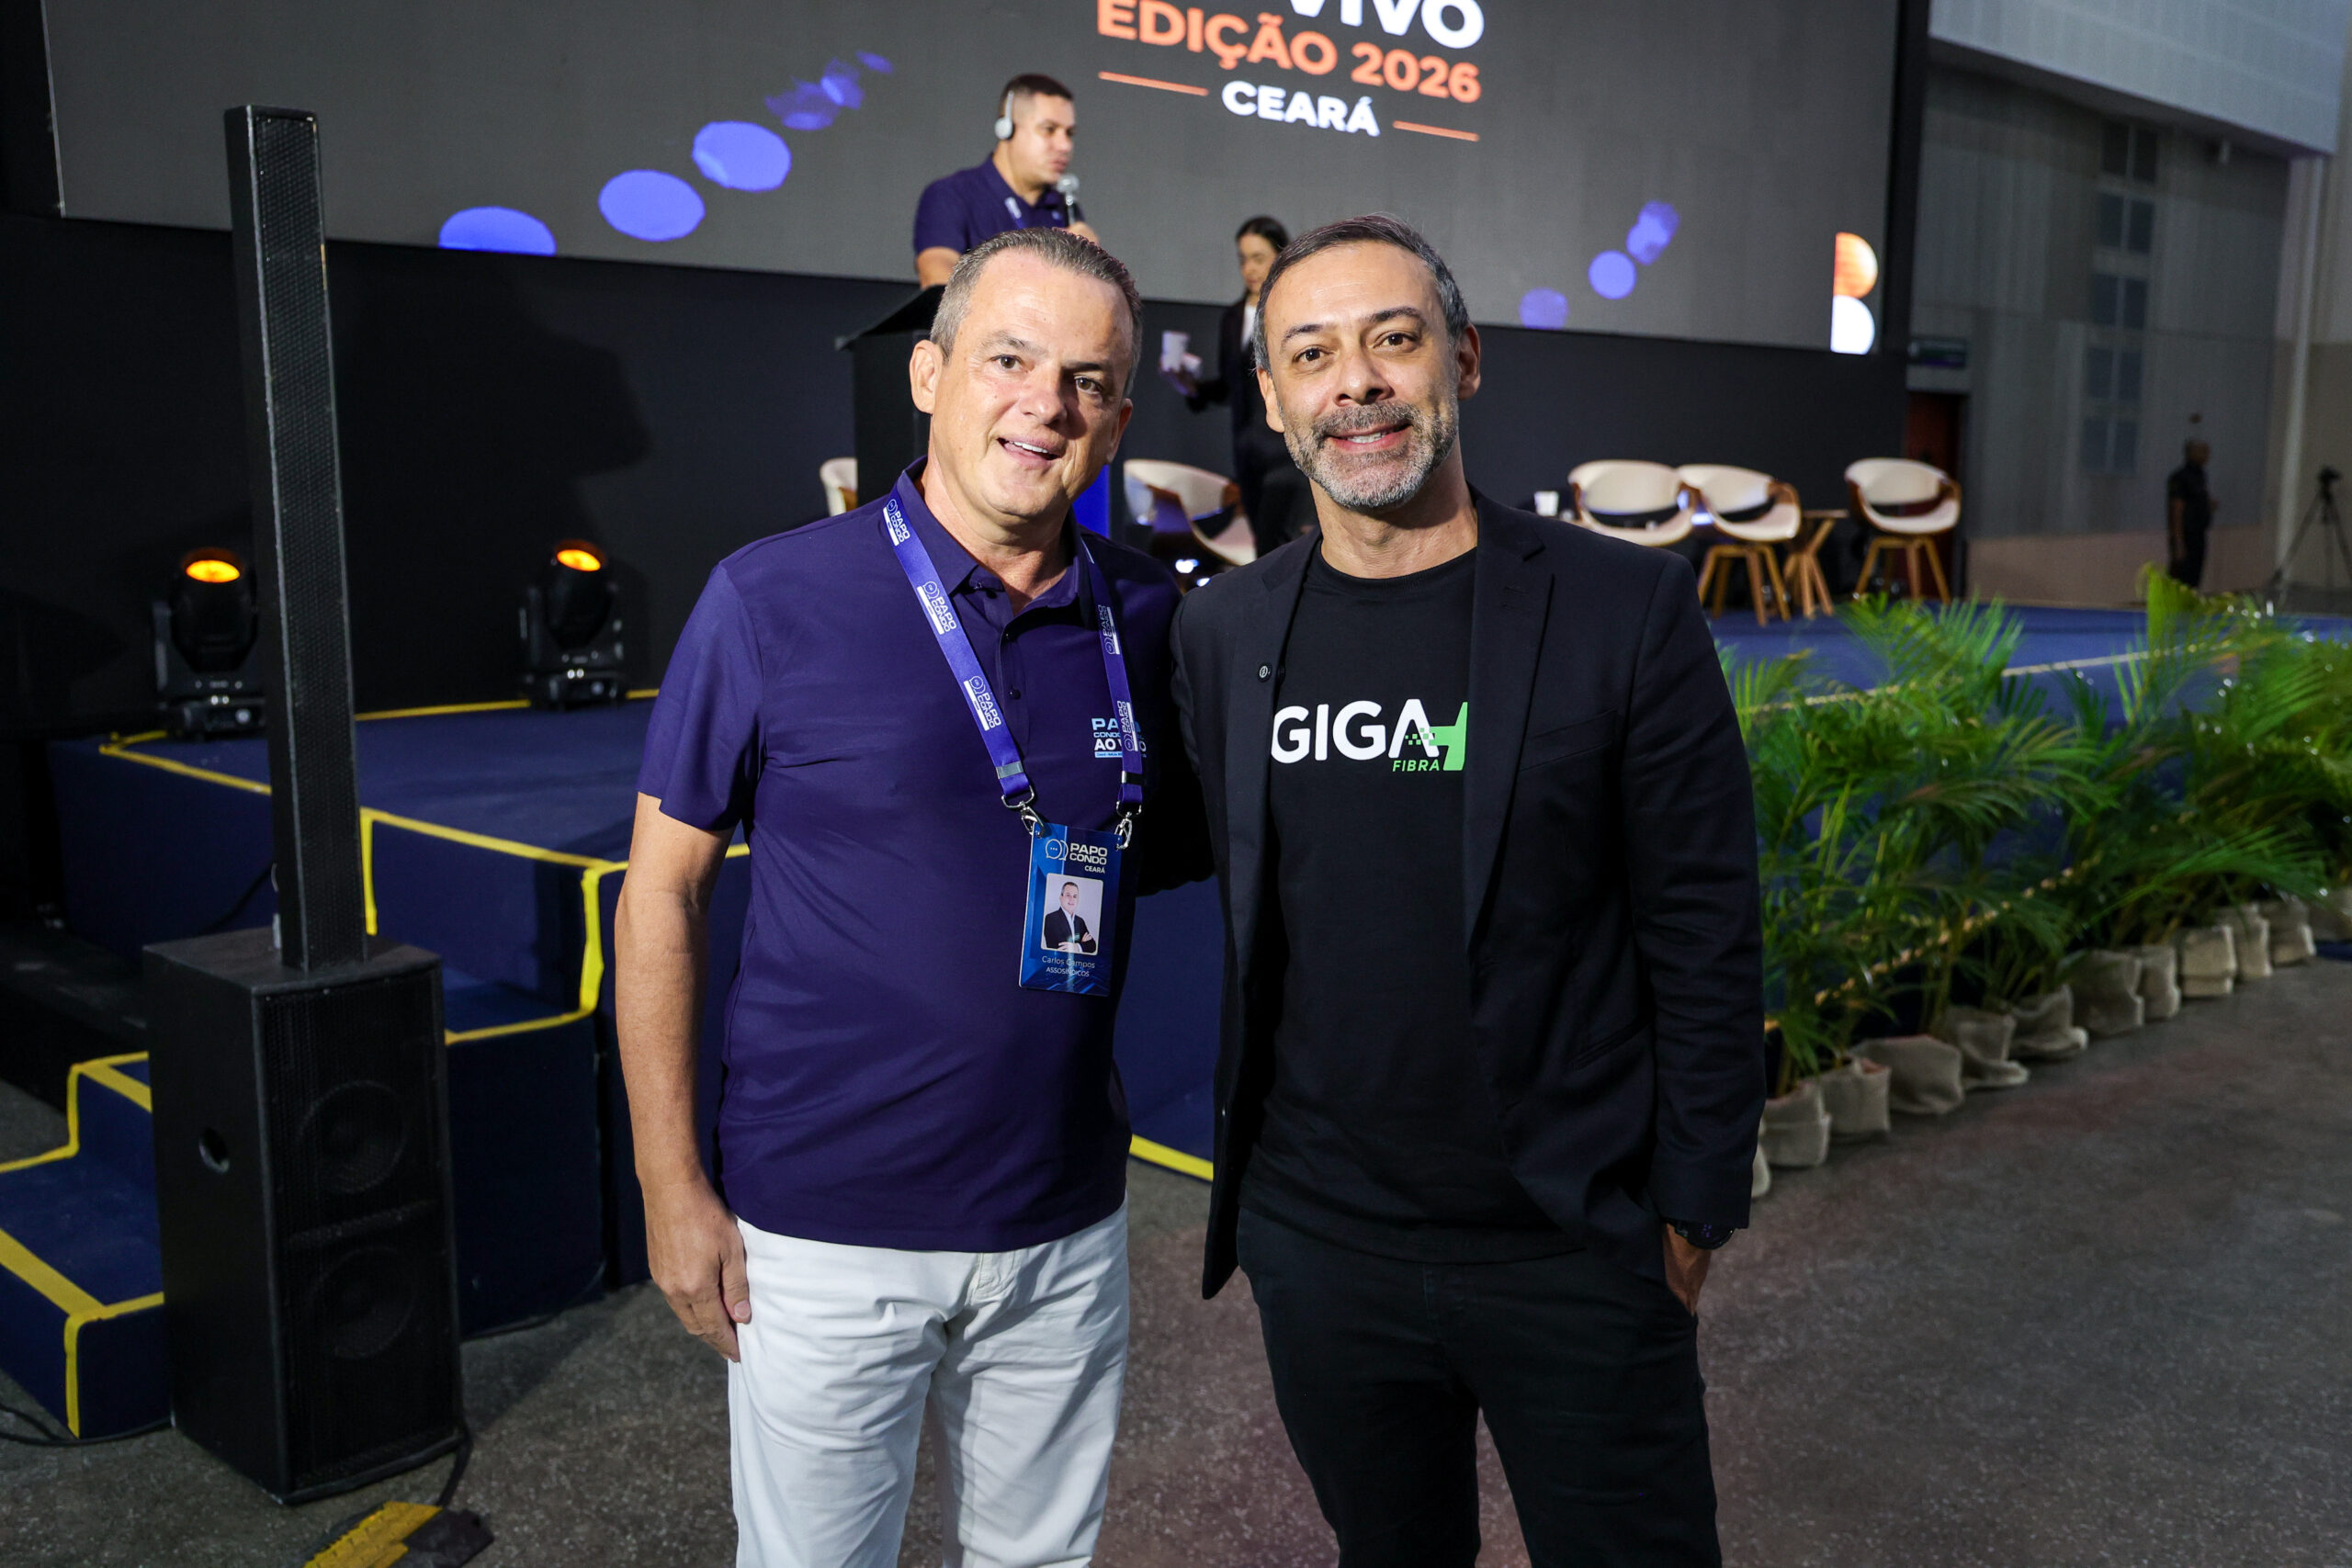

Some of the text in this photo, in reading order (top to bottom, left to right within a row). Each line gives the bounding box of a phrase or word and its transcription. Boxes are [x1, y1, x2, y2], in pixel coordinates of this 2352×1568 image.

[1097, 0, 1482, 103] EDIÇÃO 2026
[1221, 80, 1380, 137] CEARÁ
[891, 515, 905, 543] CONDO
[895, 511, 910, 540] PAPO
[931, 600, 951, 632] CONDO
[936, 596, 957, 630] PAPO
[977, 694, 996, 728] CONDO
[982, 692, 1002, 726] PAPO
[1117, 700, 1128, 733] PAPO
[1094, 738, 1116, 750] AO
[1392, 759, 1441, 773] FIBRA
[1069, 842, 1108, 857] PAPO
[1069, 852, 1107, 865] CONDO
[1041, 955, 1096, 969] Carlos Campos
